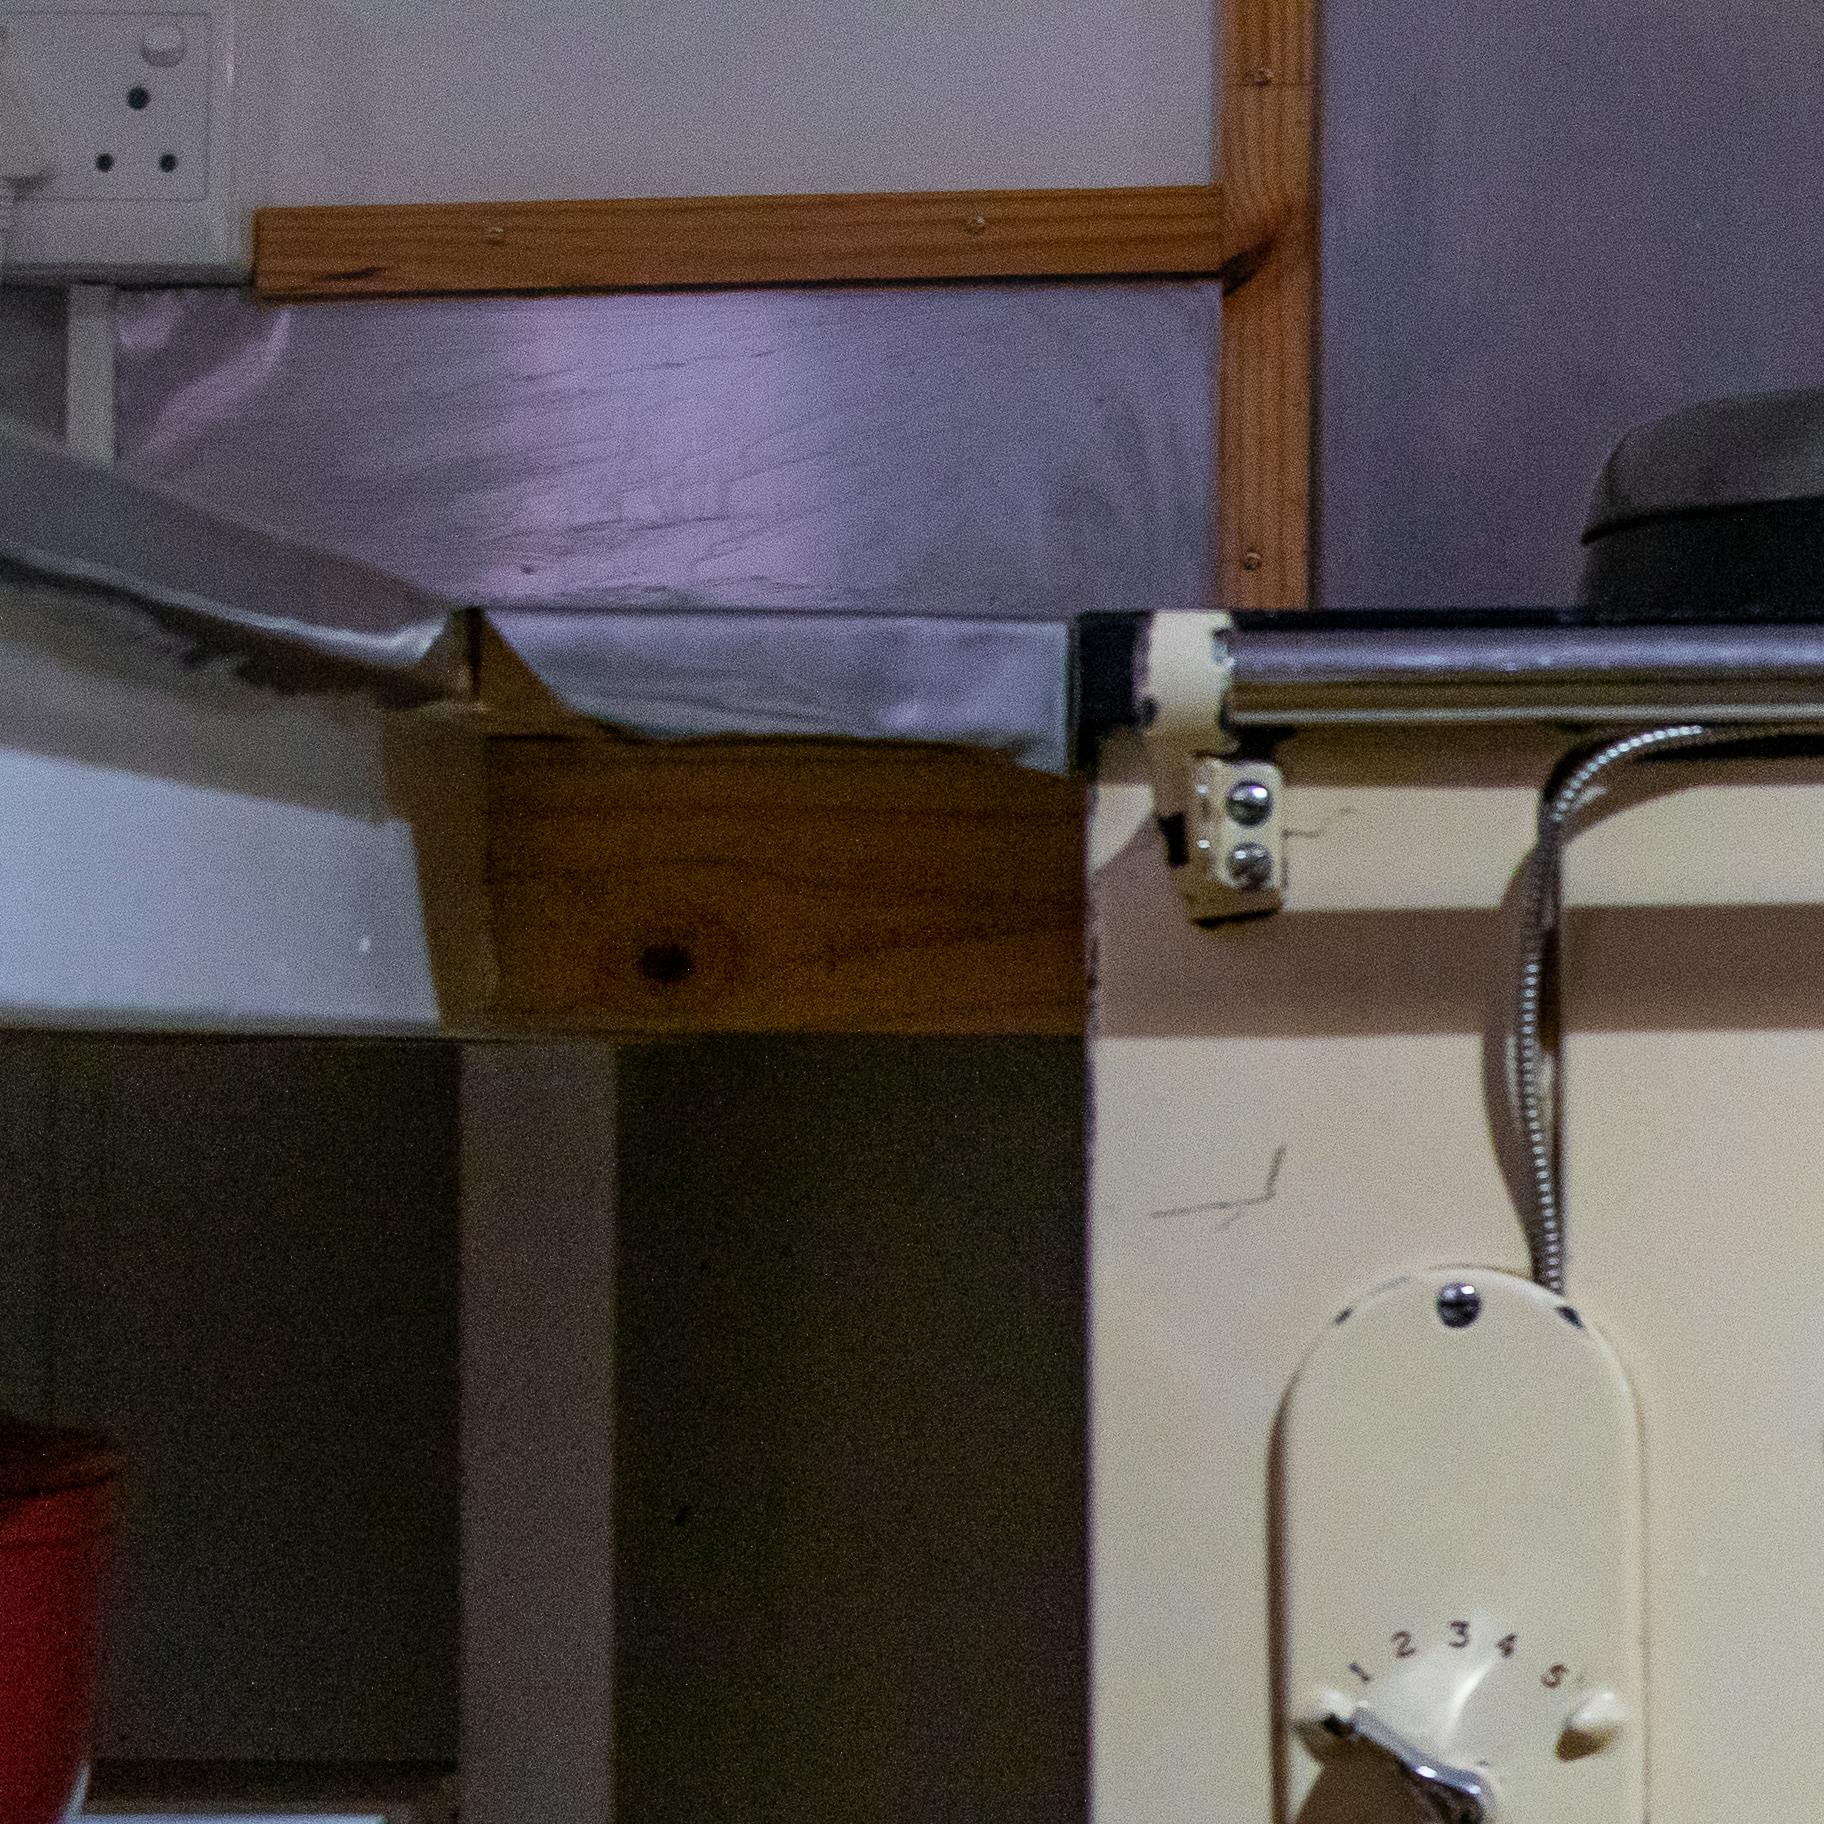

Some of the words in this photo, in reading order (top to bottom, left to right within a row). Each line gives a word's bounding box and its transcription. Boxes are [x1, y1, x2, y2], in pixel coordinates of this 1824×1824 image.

[1391, 1630, 1418, 1659] 2
[1447, 1619, 1470, 1649] 3
[1497, 1632, 1518, 1658] 4
[1540, 1663, 1569, 1689] 5
